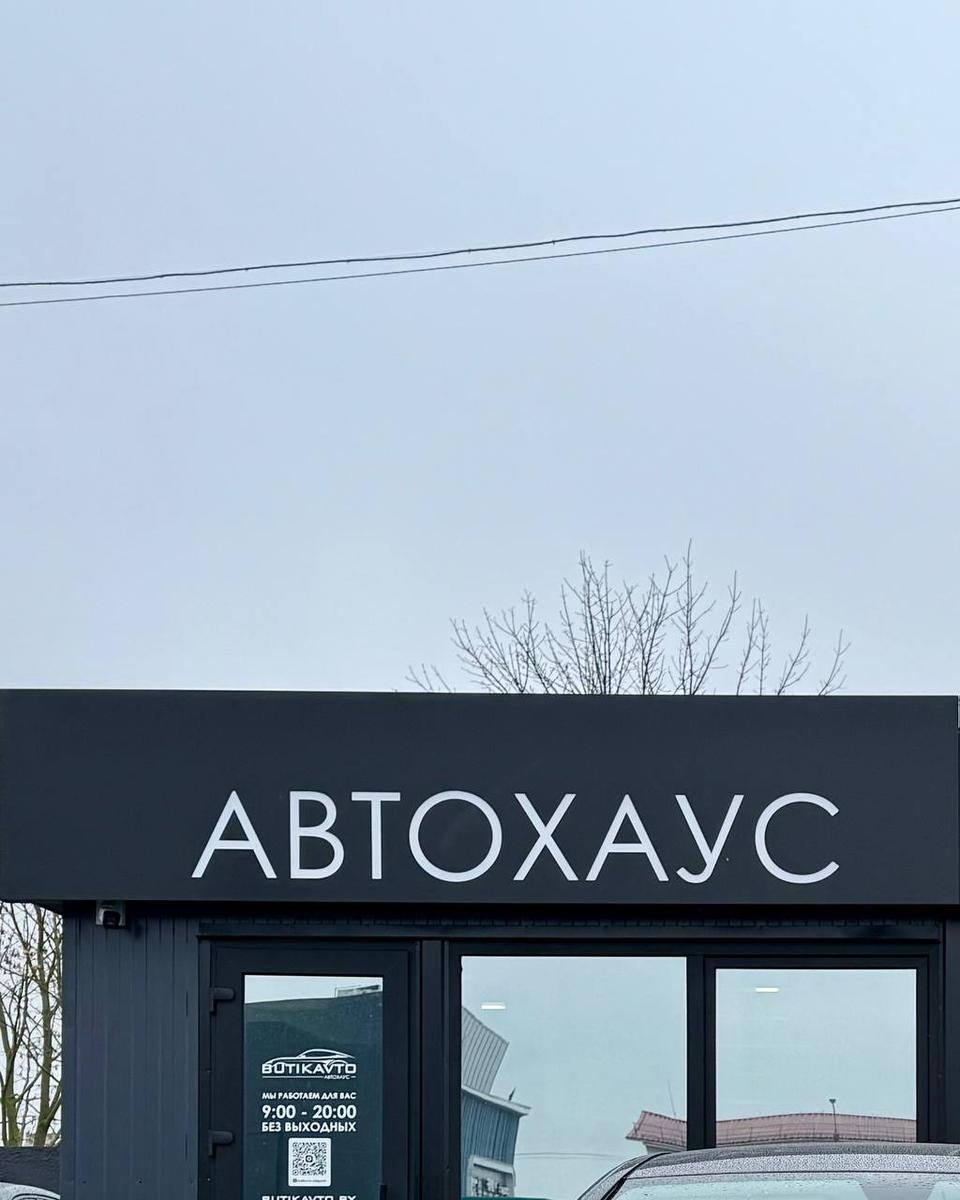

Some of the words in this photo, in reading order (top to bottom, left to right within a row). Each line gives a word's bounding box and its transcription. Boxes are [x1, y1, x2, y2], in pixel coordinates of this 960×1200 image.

[191, 790, 840, 883] АВТОХАУС
[262, 1063, 357, 1074] BUTIKAVTO
[262, 1092, 276, 1100] МЫ
[278, 1092, 320, 1100] РАБОТАЕМ
[321, 1092, 338, 1101] ДЛЯ
[339, 1092, 357, 1100] ВАС
[262, 1105, 296, 1119] 9:00
[312, 1105, 357, 1119] 20:00
[262, 1122, 281, 1132] БЕЗ
[284, 1122, 357, 1133] ВЫХОДНЫХ
